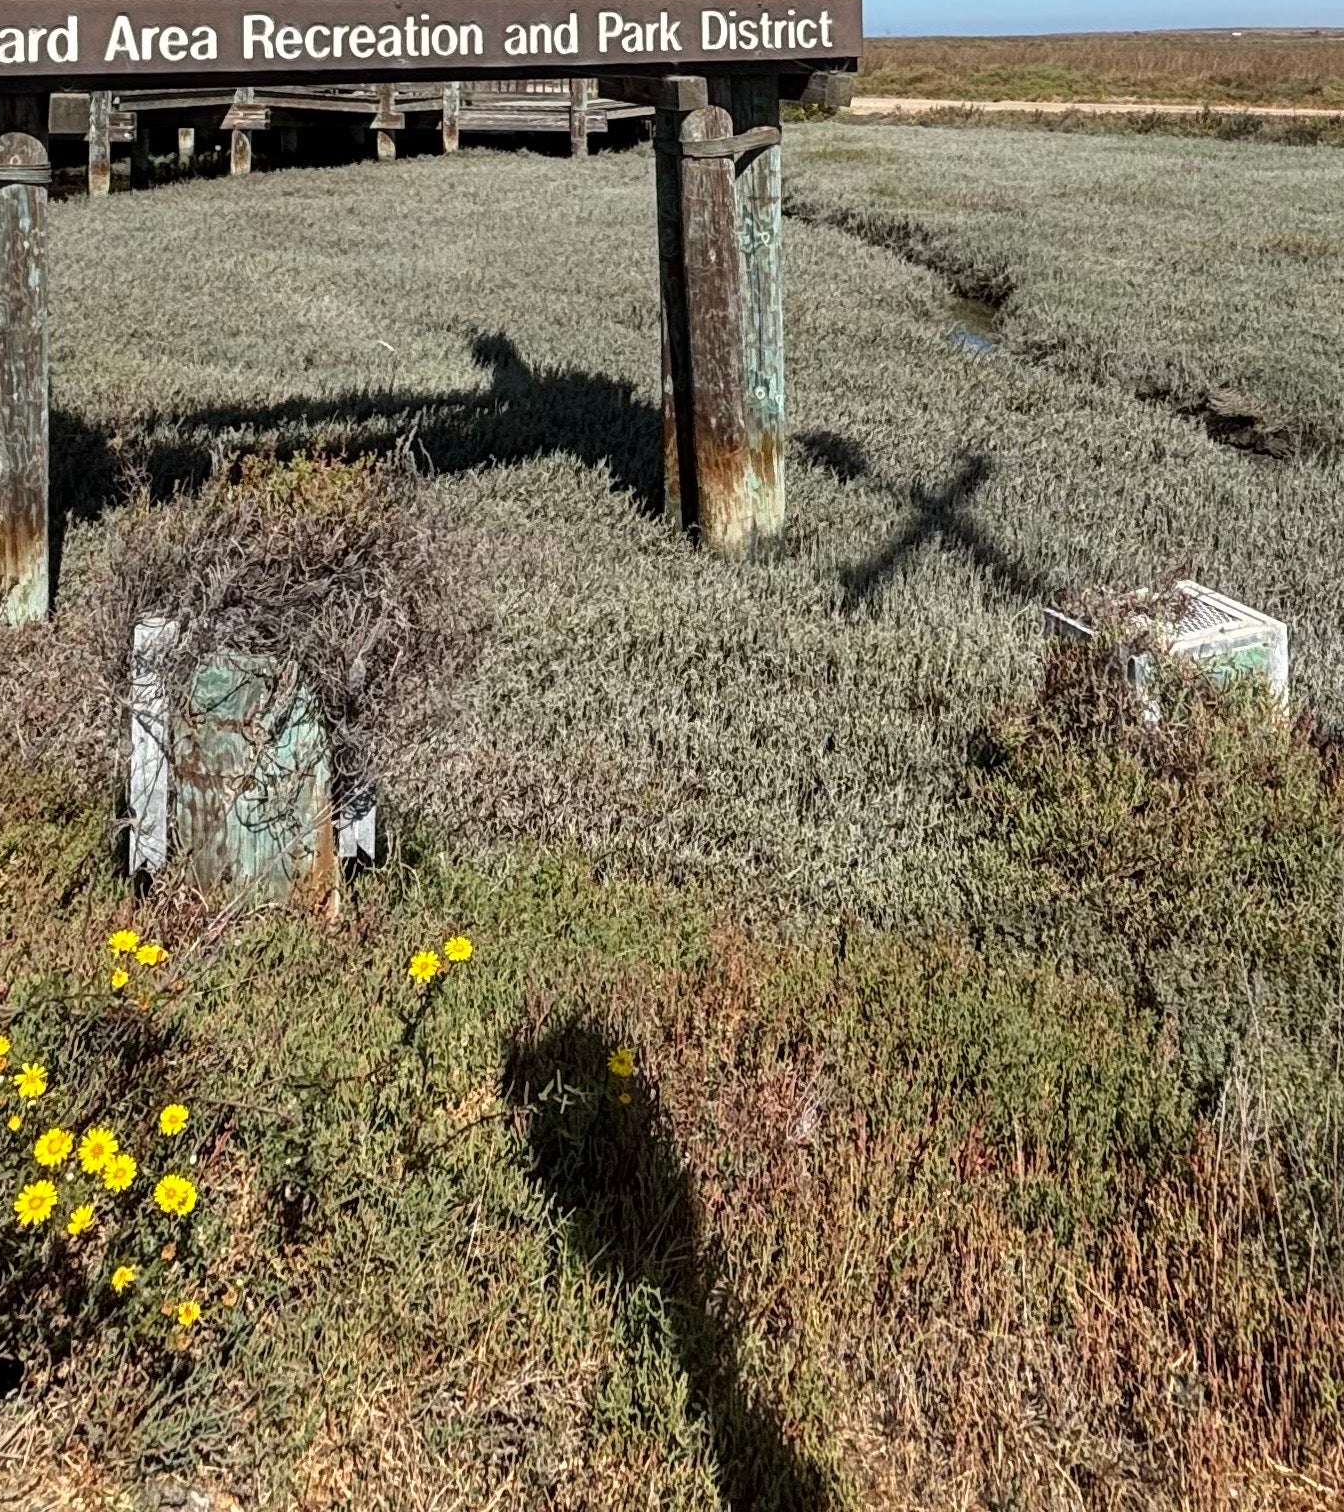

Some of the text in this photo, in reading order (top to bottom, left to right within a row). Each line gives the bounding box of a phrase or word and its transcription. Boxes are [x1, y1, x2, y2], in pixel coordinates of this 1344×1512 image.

[104, 14, 218, 62] Area
[242, 13, 484, 60] Recreation
[503, 12, 579, 55] and
[597, 11, 683, 53] Park
[701, 10, 834, 51] District
